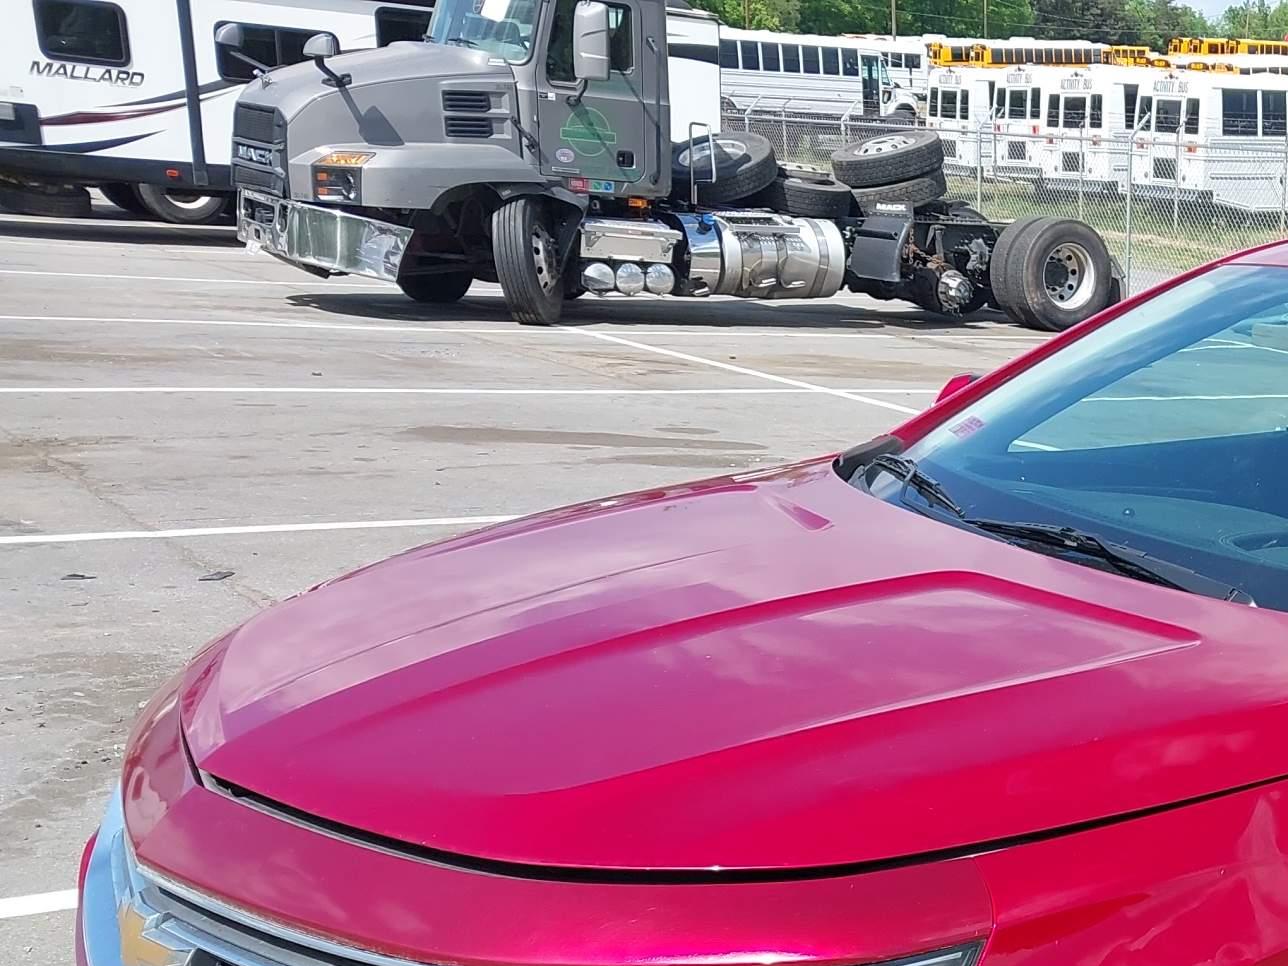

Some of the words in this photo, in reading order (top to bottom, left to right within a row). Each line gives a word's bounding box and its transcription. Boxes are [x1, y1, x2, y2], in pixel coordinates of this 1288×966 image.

[29, 61, 145, 86] MALLARD
[1060, 79, 1080, 90] ACTIVITY
[1083, 79, 1093, 90] BUS
[1153, 80, 1175, 93] ACTIVITY
[1178, 80, 1189, 93] BUS
